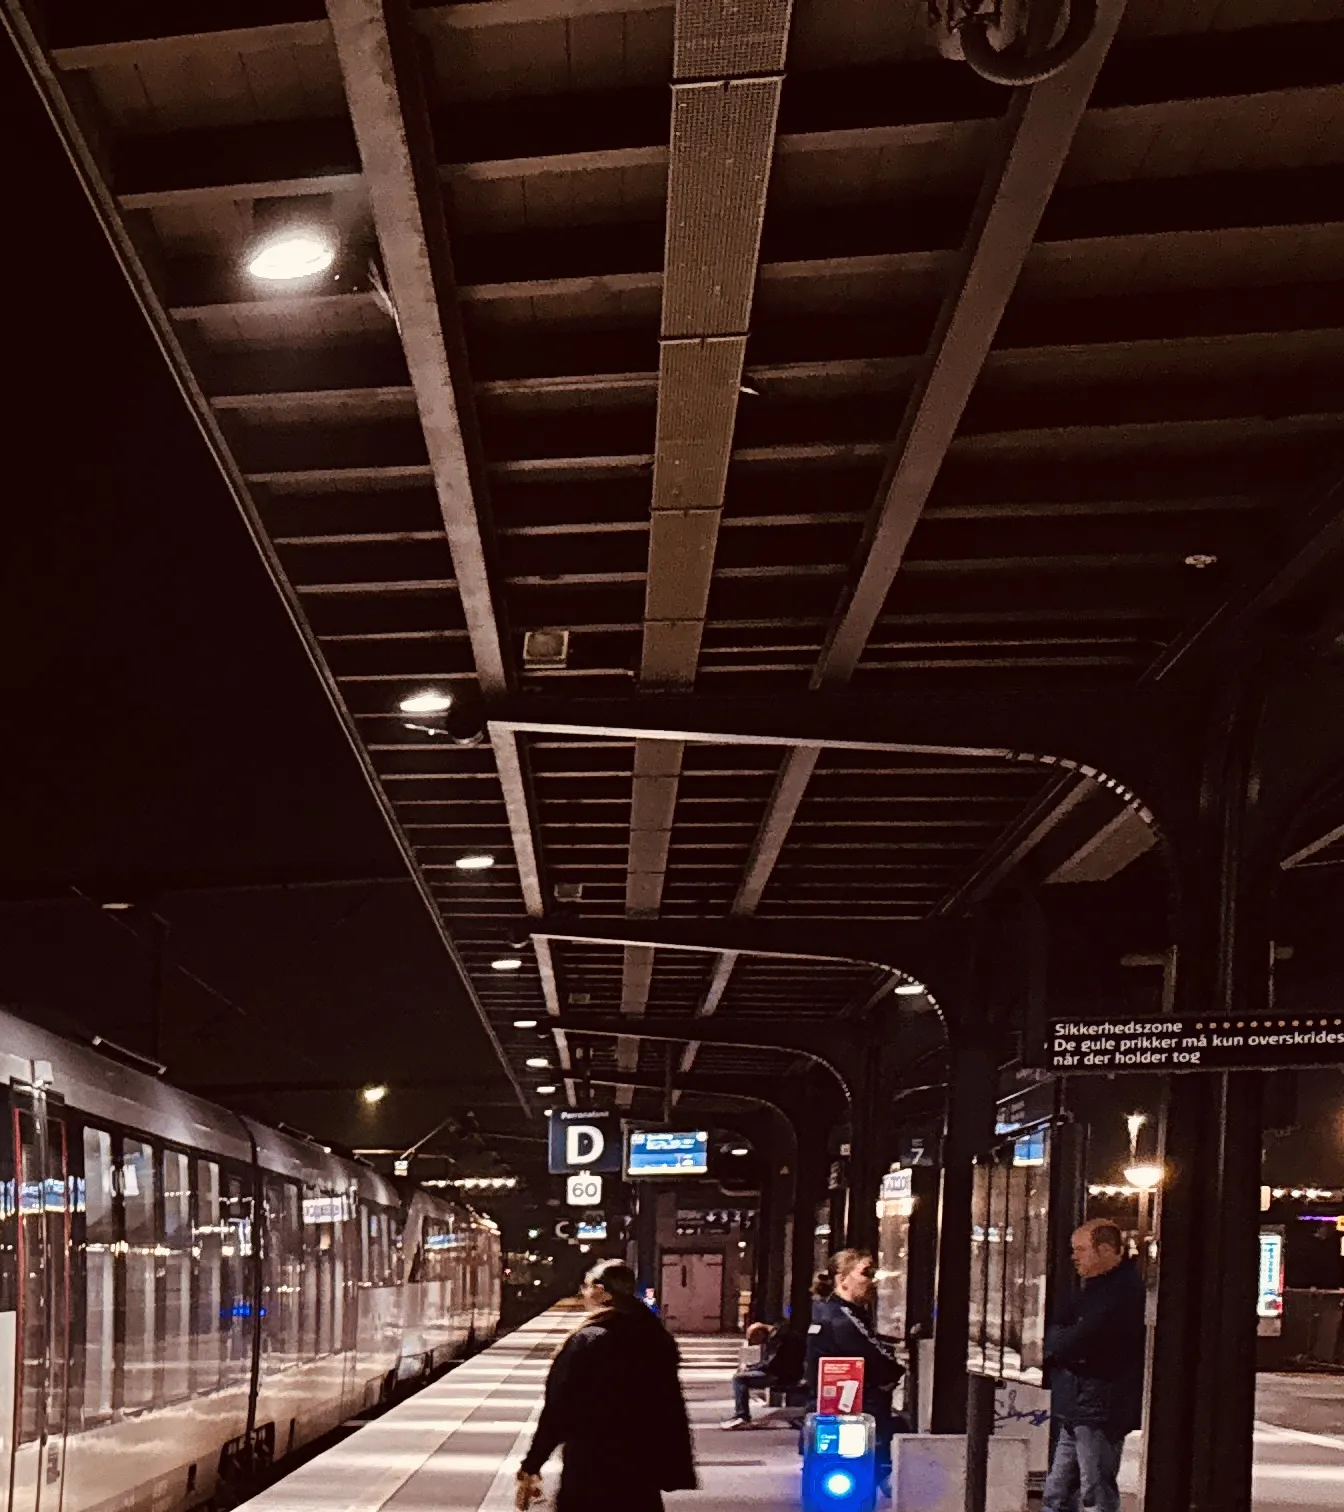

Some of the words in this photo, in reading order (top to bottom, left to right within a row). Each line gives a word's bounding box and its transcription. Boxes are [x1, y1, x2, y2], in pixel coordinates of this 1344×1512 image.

[1054, 1021, 1183, 1036] Sikkerhedszone
[1053, 1038, 1076, 1052] De
[1081, 1038, 1115, 1052] gule
[1120, 1036, 1179, 1051] prikker
[1182, 1034, 1208, 1048] må
[1212, 1034, 1244, 1047] kun
[1248, 1030, 1344, 1046] overskrides
[1053, 1052, 1080, 1066] når
[1084, 1052, 1111, 1065] der
[1114, 1050, 1168, 1064] holder
[1172, 1051, 1201, 1064] tog
[566, 1125, 605, 1165] D
[572, 1182, 598, 1198] 60
